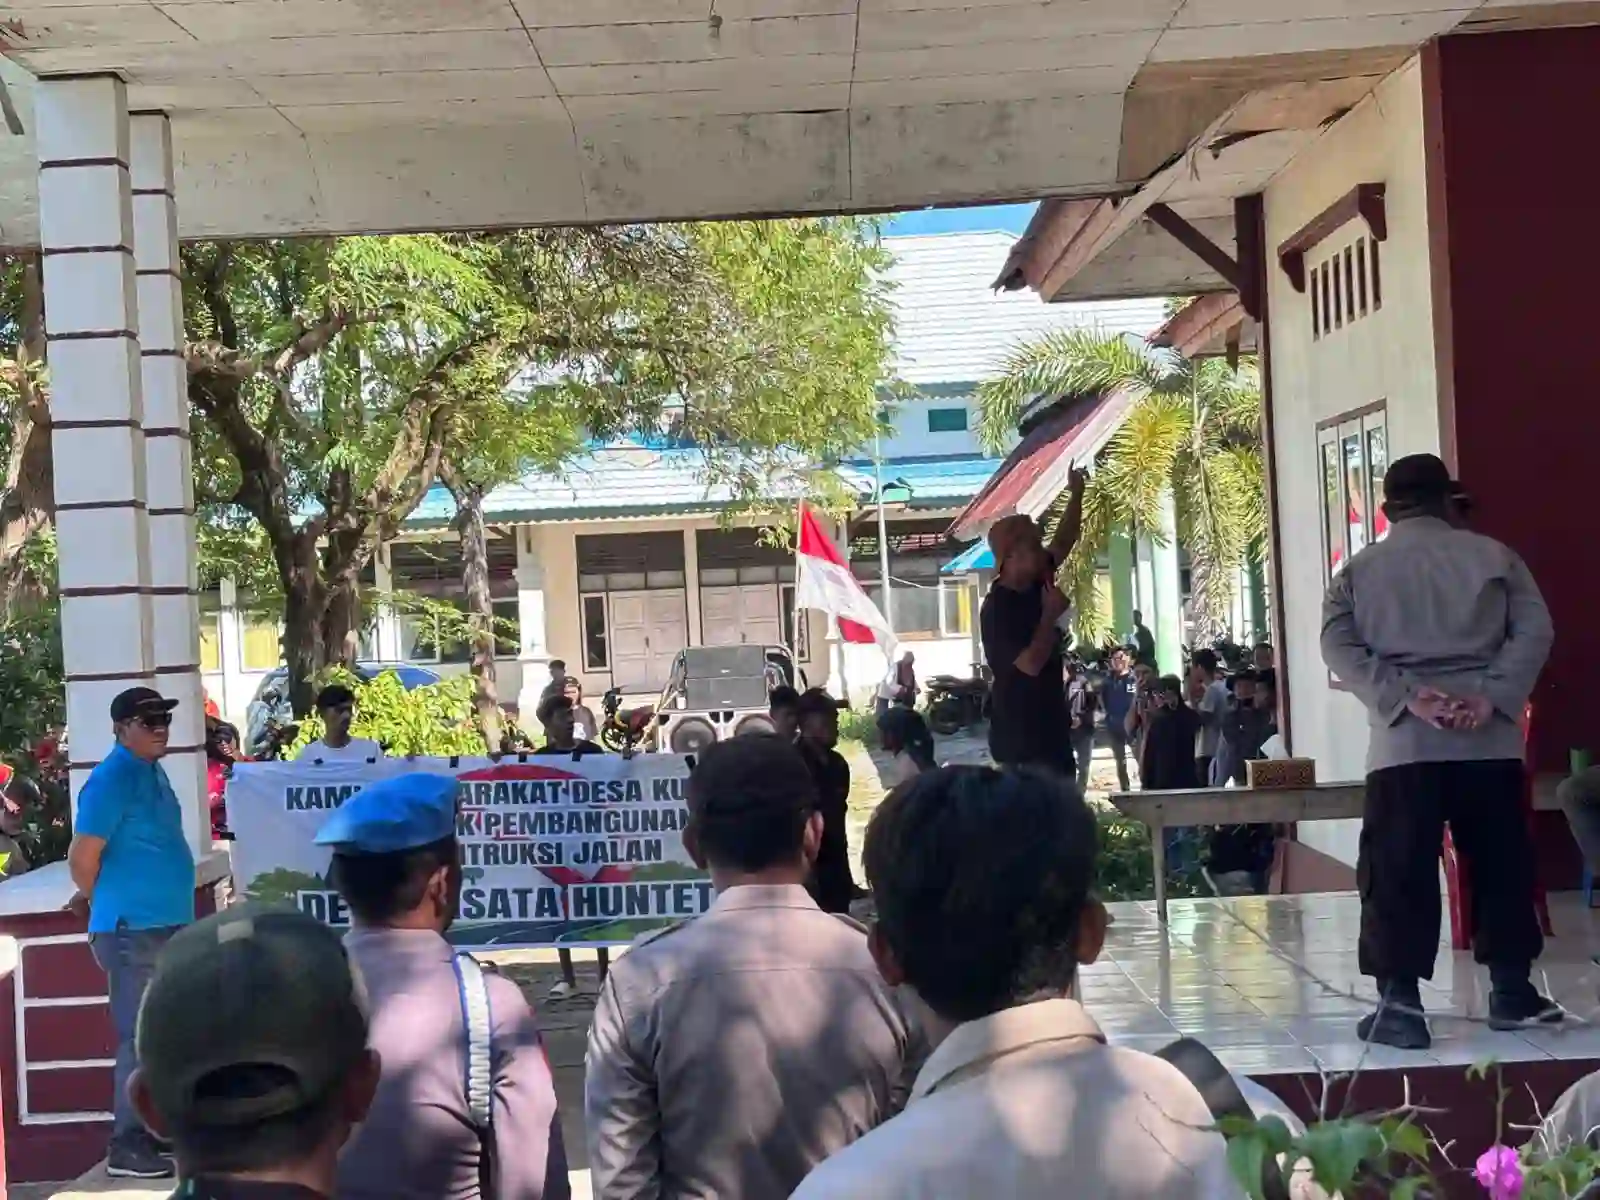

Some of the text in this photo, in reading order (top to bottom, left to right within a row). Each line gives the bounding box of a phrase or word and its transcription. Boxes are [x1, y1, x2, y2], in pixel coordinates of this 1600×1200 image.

[286, 778, 687, 810] KAM ARAKAT DESA KU
[572, 839, 662, 863] JALAN
[300, 883, 713, 924] DE SATA HUNTET
